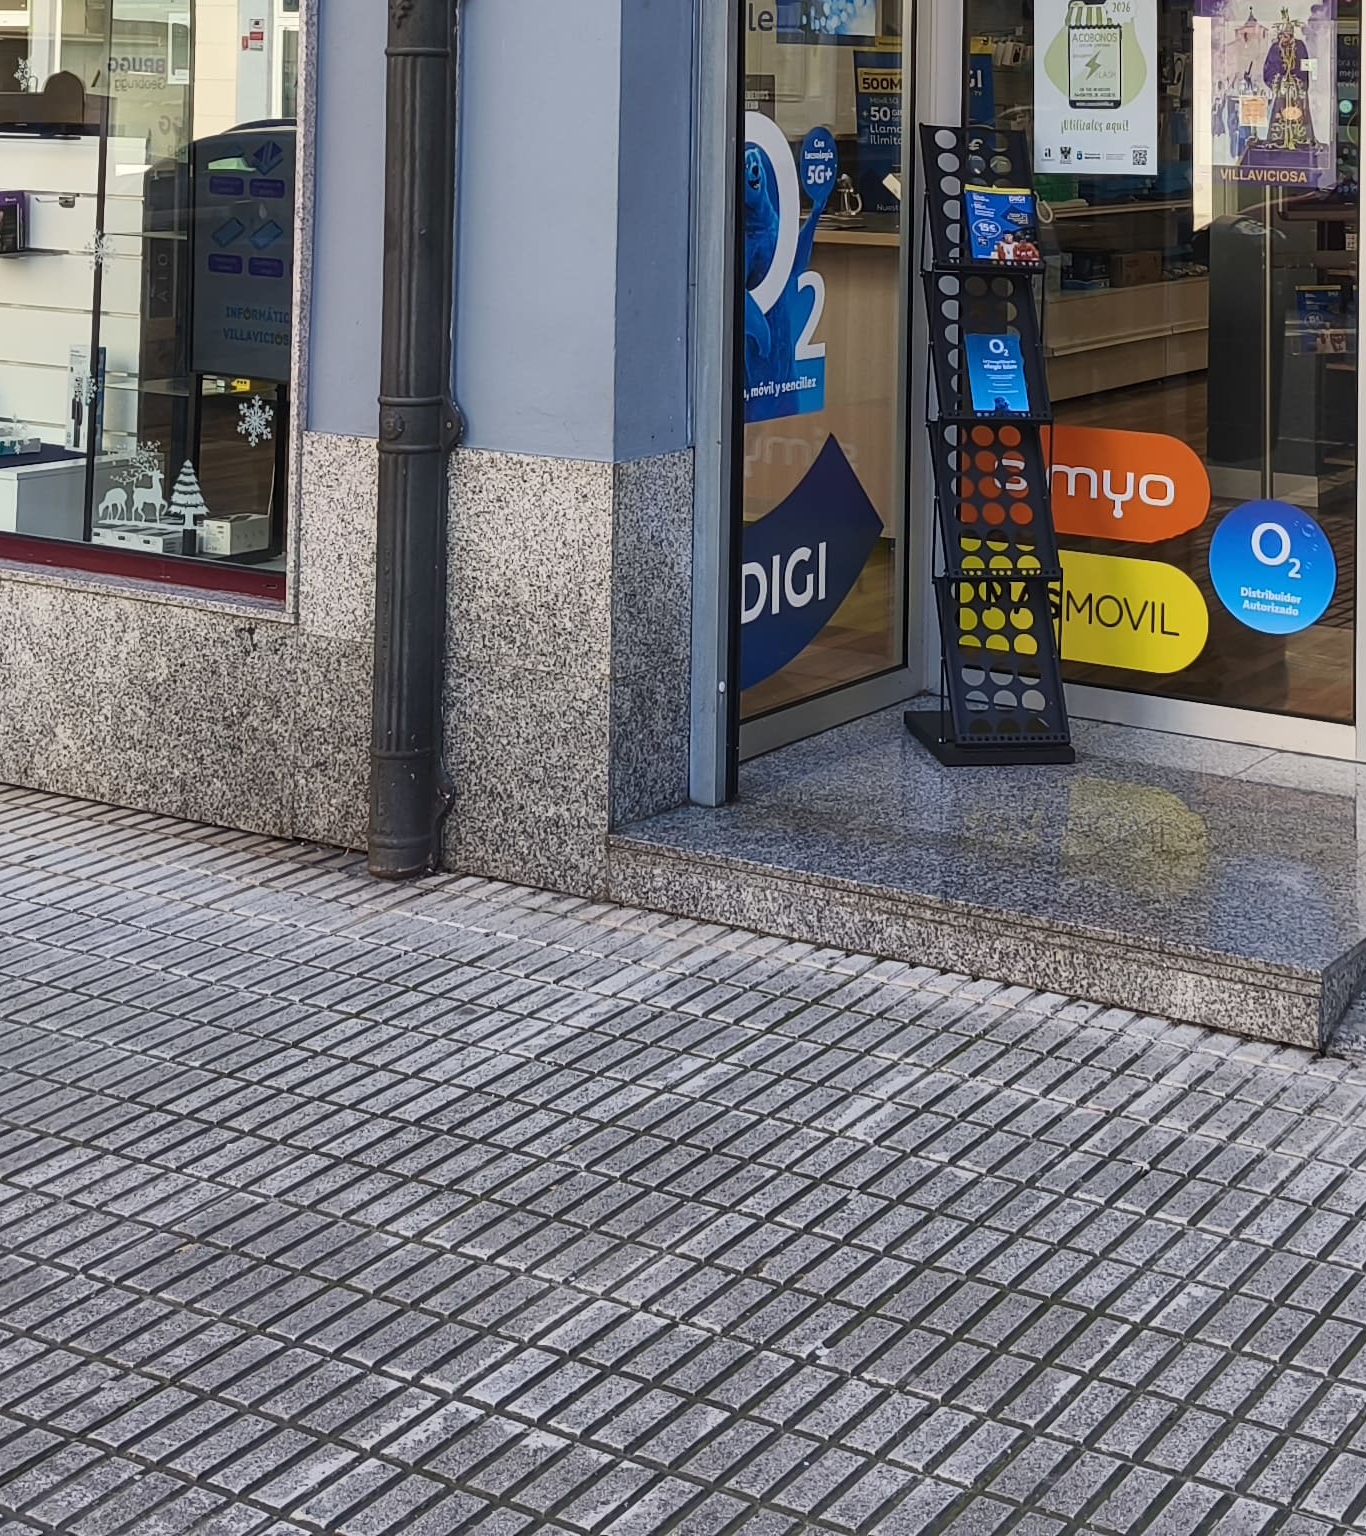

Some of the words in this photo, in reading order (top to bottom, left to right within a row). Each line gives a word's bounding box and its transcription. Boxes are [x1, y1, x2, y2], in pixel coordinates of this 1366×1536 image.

[1112, 1, 1131, 13] 2026
[1072, 32, 1118, 44] ACOBONOS
[806, 165, 833, 185] 5G+
[1220, 167, 1308, 184] VILLAVICIOSA
[750, 380, 774, 398] móvil
[774, 384, 781, 398] y
[781, 375, 817, 394] sencillez
[740, 541, 827, 625] DIGI
[1240, 586, 1303, 605] Distribuidor
[1242, 599, 1299, 617] Autorizado
